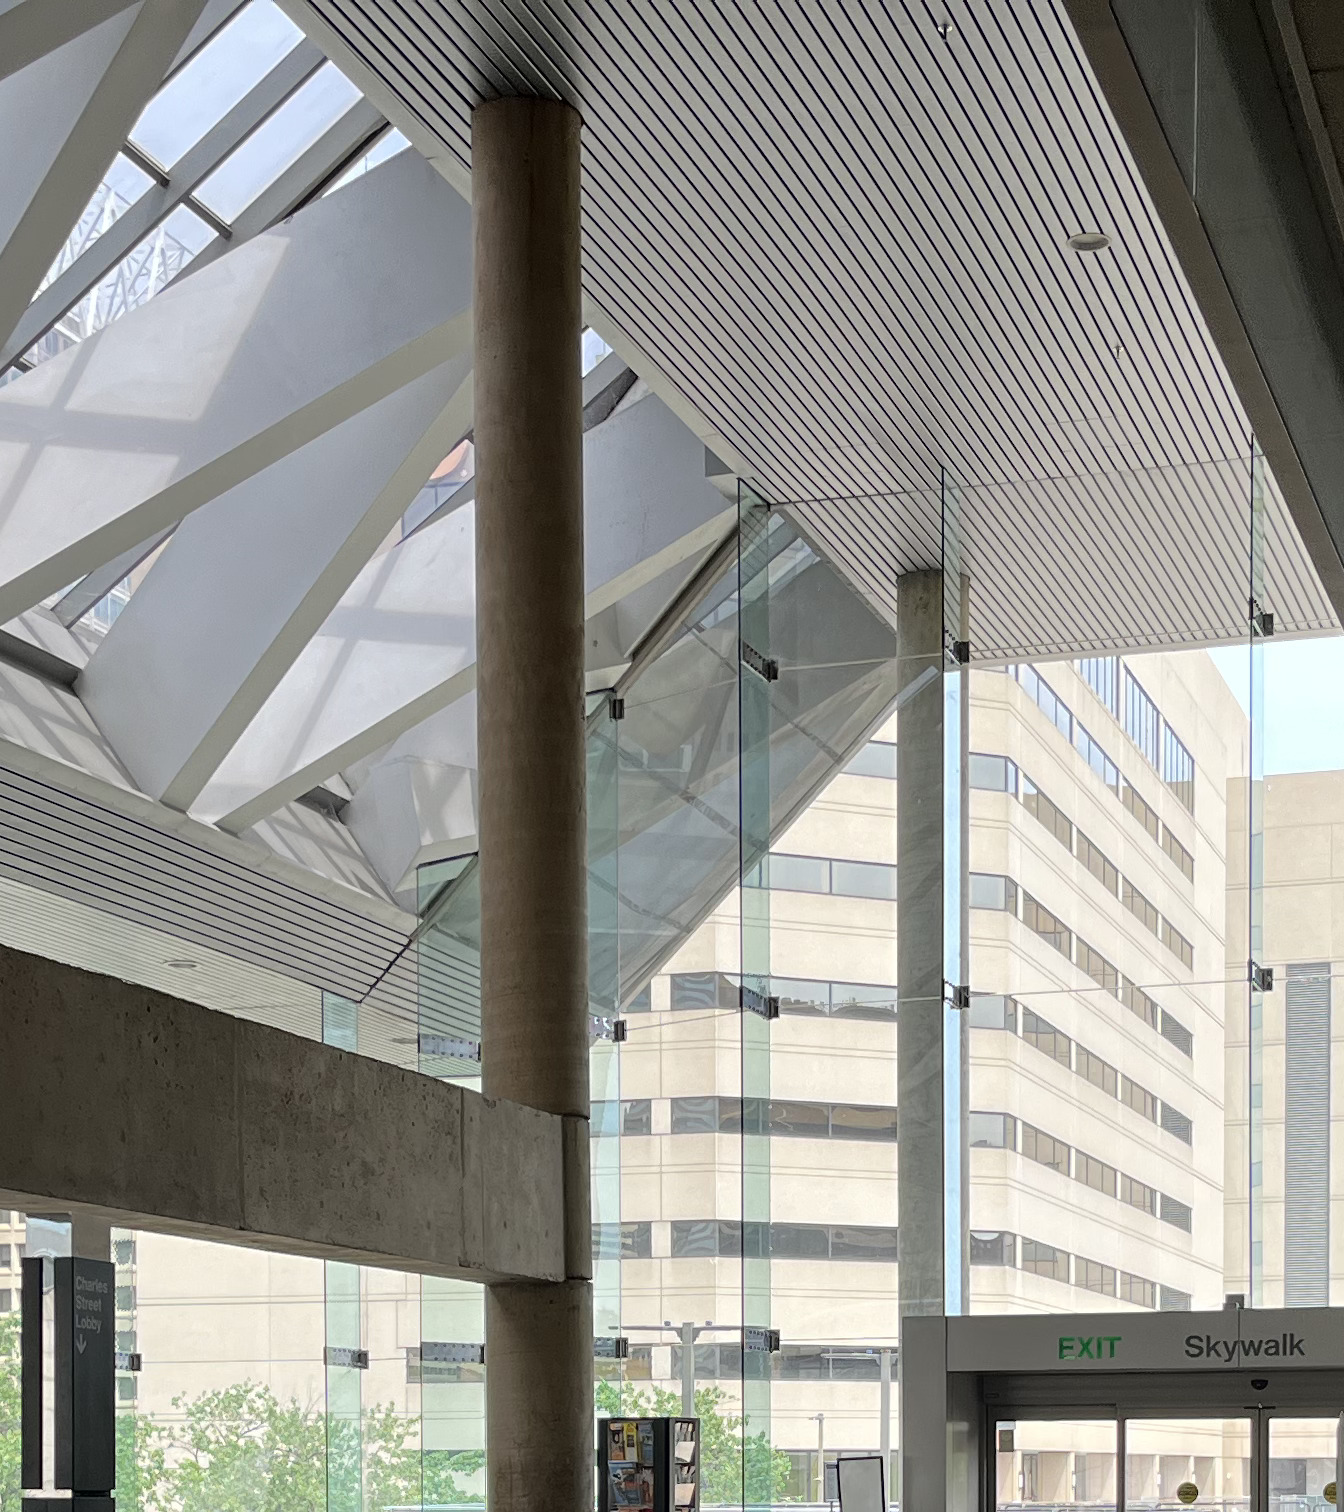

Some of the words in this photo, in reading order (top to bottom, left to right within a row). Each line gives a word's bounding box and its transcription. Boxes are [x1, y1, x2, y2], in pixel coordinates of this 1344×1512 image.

[75, 1275, 108, 1294] Charles
[75, 1295, 102, 1312] Street
[75, 1314, 102, 1333] Lobby
[1058, 1336, 1123, 1360] EXIT
[1184, 1333, 1307, 1362] Skywalk
